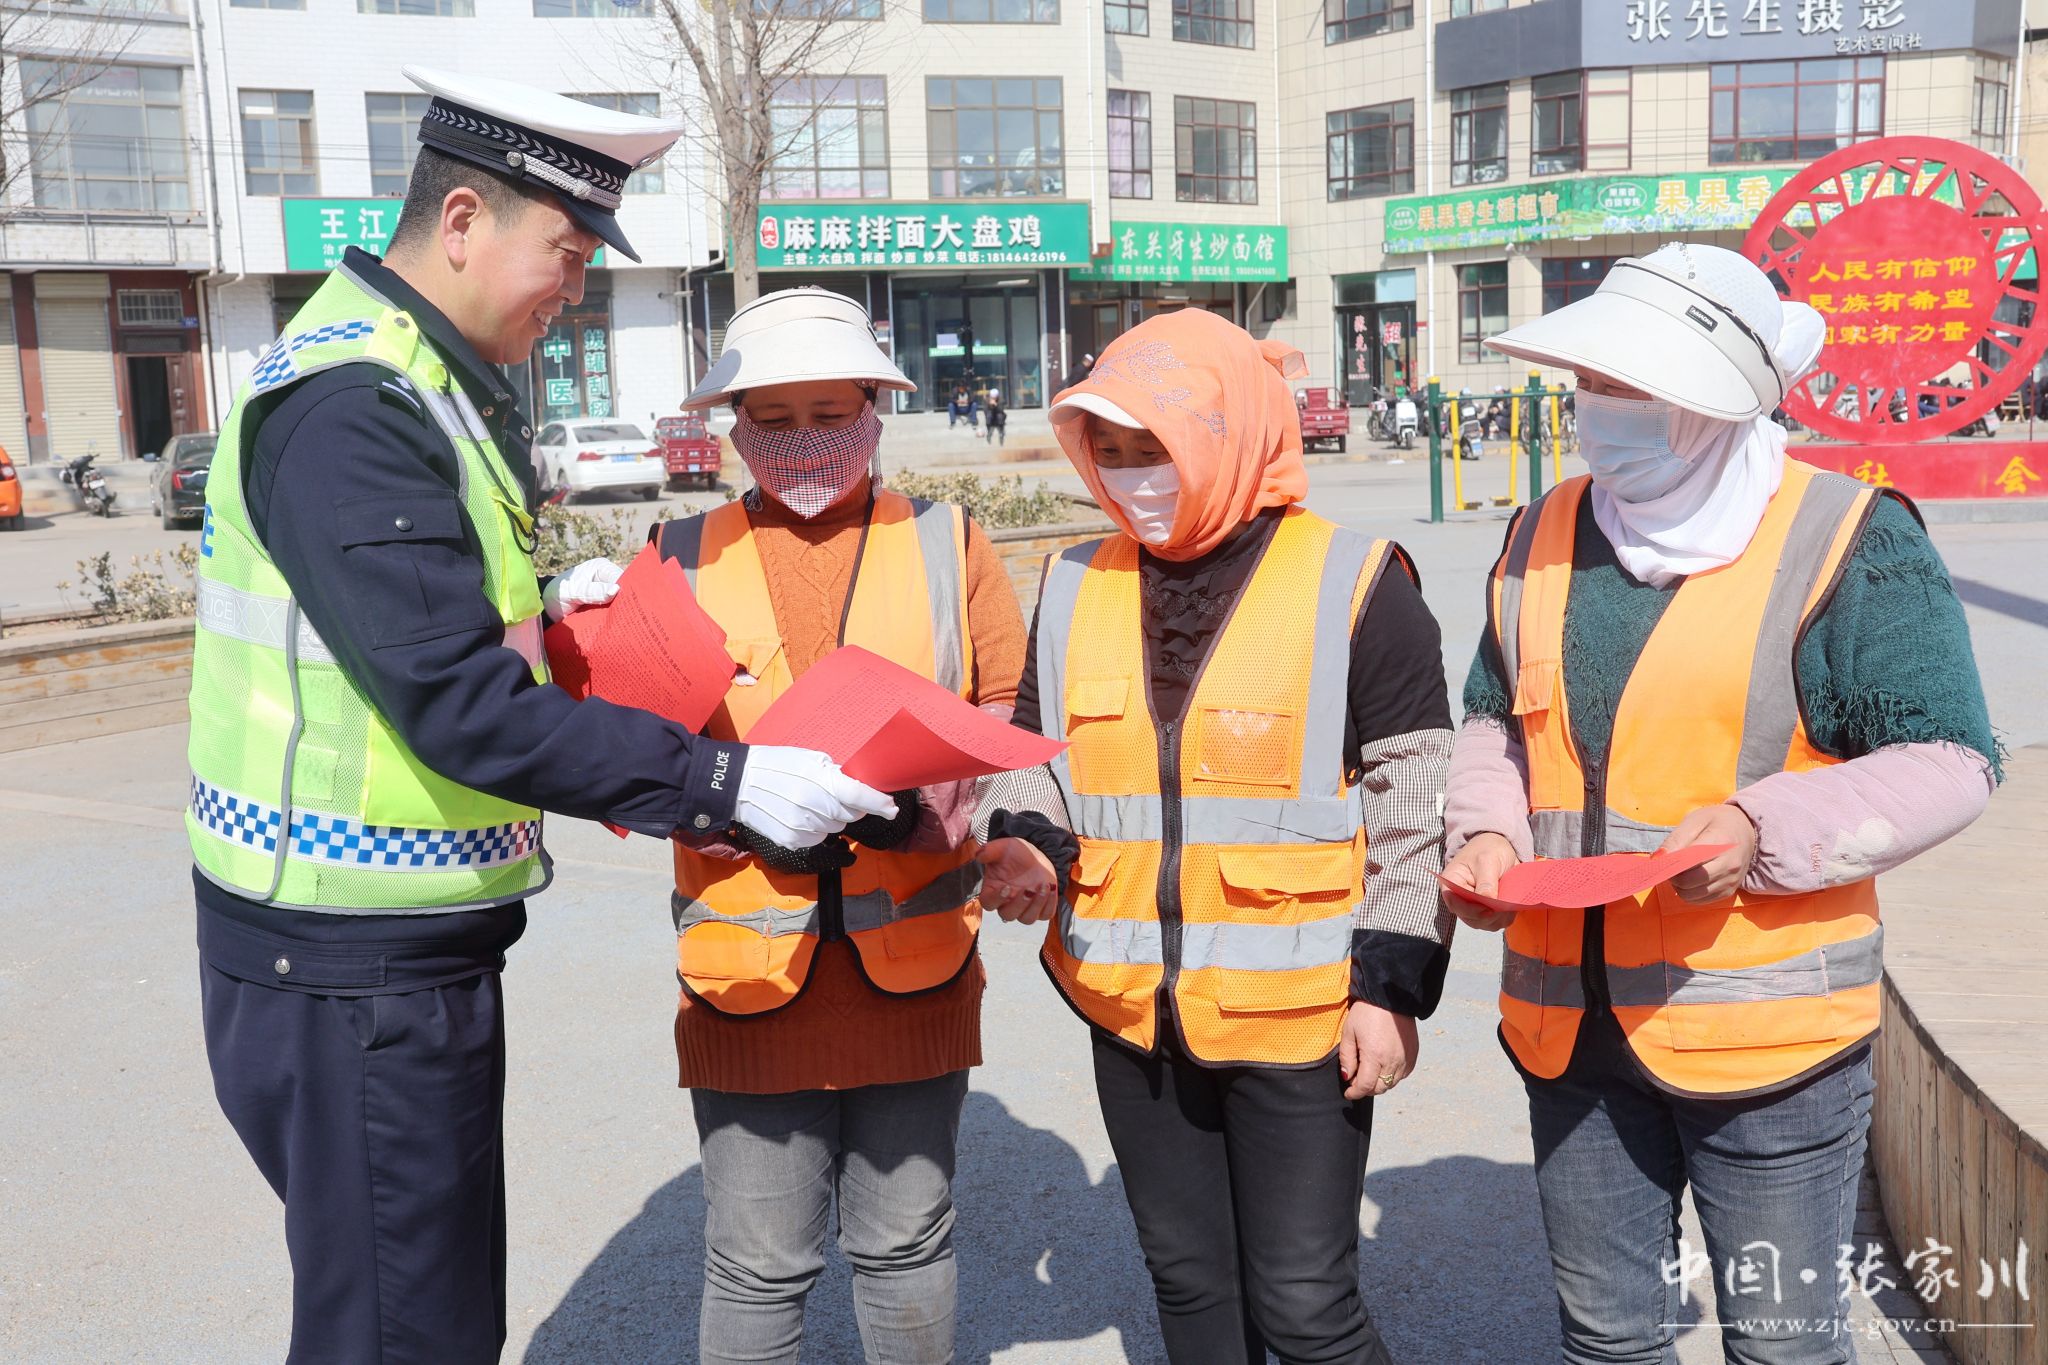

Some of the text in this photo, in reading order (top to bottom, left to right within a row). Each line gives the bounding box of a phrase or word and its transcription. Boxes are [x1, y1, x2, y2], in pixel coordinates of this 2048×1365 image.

[1626, 0, 1906, 41] 张先生摄影
[1834, 33, 1922, 53] 艺术空间社
[1418, 191, 1559, 232] 果果香生活超市
[784, 215, 1042, 250] 麻麻拌面大盘鸡
[1120, 227, 1276, 262] 东关牙生炒面馆
[861, 252, 886, 264] 拌面
[891, 251, 917, 264] 炒面
[1808, 255, 1977, 283] 人民有信仰
[1808, 288, 1973, 315] 民族有希望
[544, 328, 610, 419] 中医 拔罐刮痧
[1995, 456, 2042, 494] 会
[710, 750, 730, 791] POLICE
